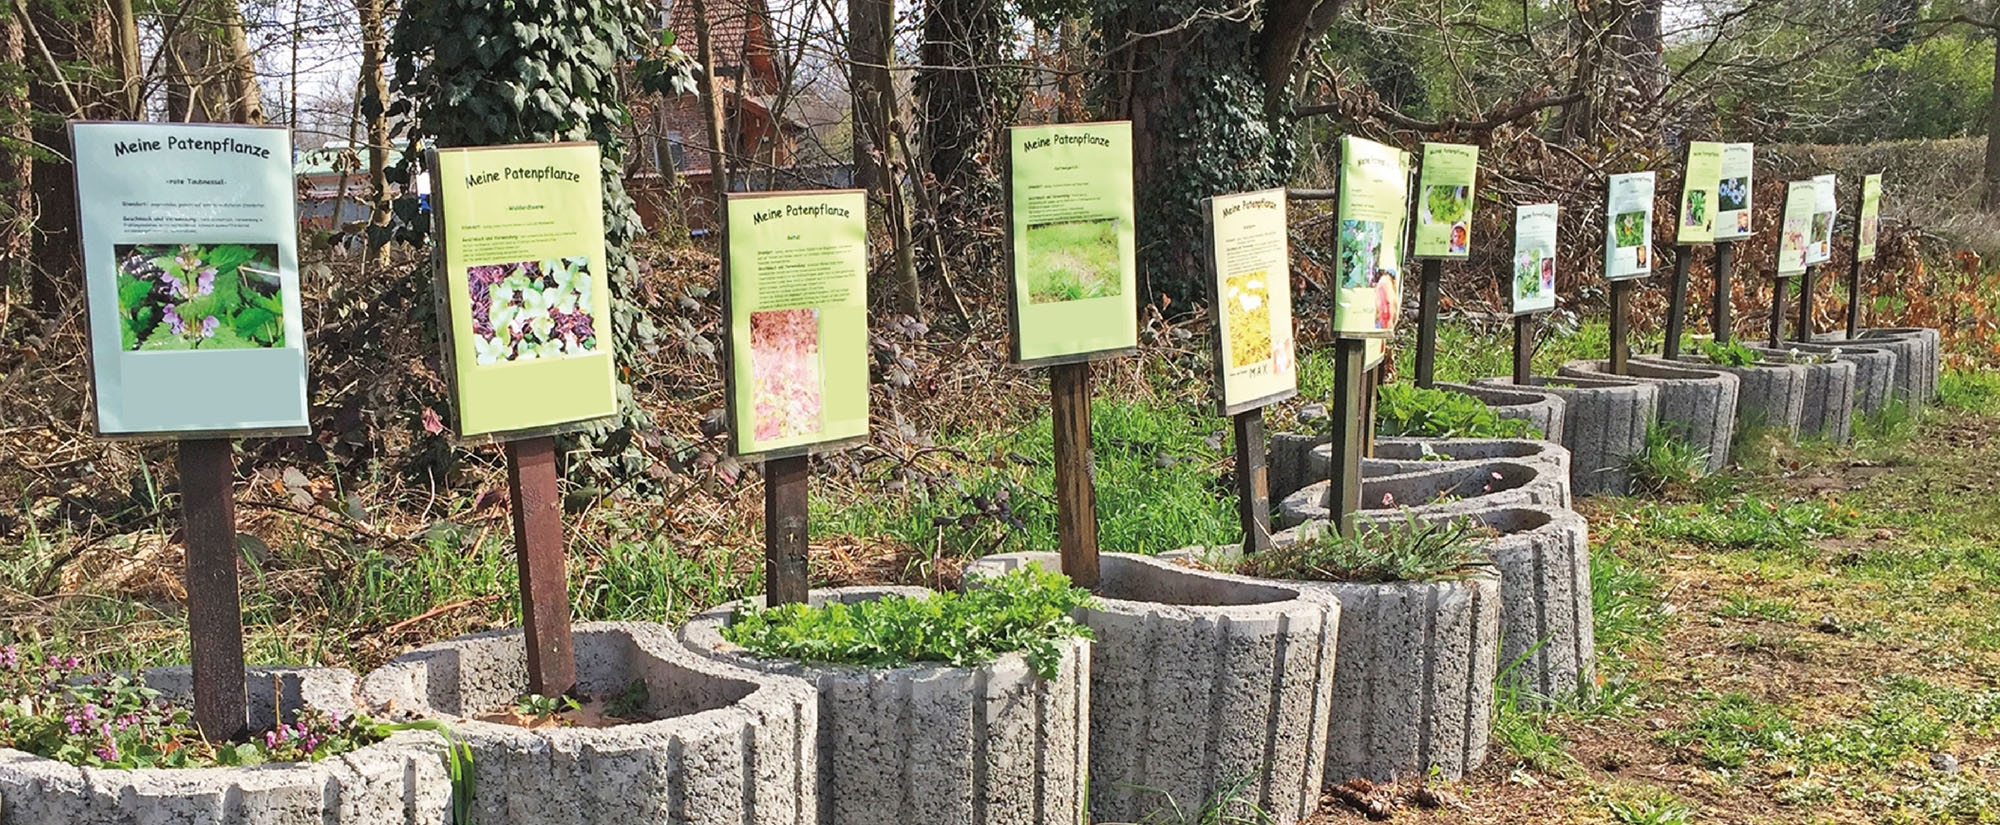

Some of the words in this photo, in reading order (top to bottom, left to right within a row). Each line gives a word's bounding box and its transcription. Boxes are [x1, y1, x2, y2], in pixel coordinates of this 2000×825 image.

[114, 138, 161, 158] Meine
[168, 136, 271, 159] Patenpflanze
[1023, 137, 1051, 153] Meine
[1054, 132, 1110, 148] Patenpflanze
[465, 170, 501, 189] Meine
[504, 166, 580, 183] Patenpflanze
[753, 208, 783, 226] Meine
[786, 203, 850, 219] Patenpflanze
